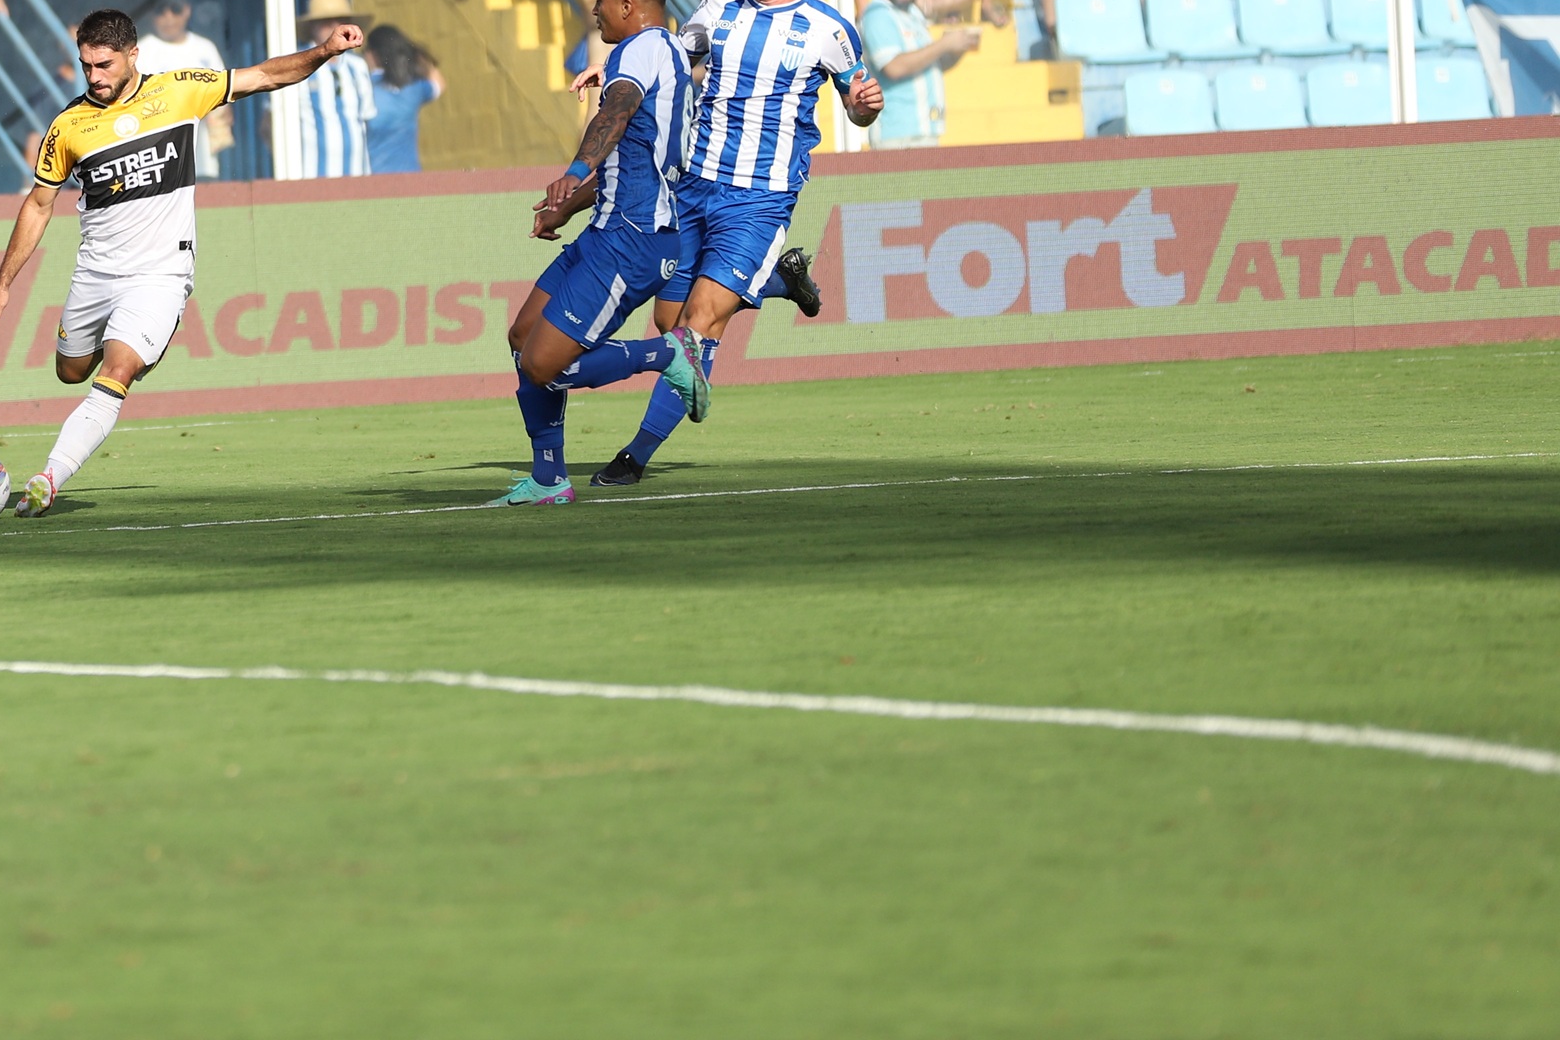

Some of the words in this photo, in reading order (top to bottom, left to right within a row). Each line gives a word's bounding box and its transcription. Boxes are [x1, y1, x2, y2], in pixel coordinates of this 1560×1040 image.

[174, 71, 219, 83] unesc
[41, 126, 60, 172] unesc
[90, 142, 179, 183] ESTRELA
[124, 163, 166, 191] BET
[841, 188, 1186, 324] Fort
